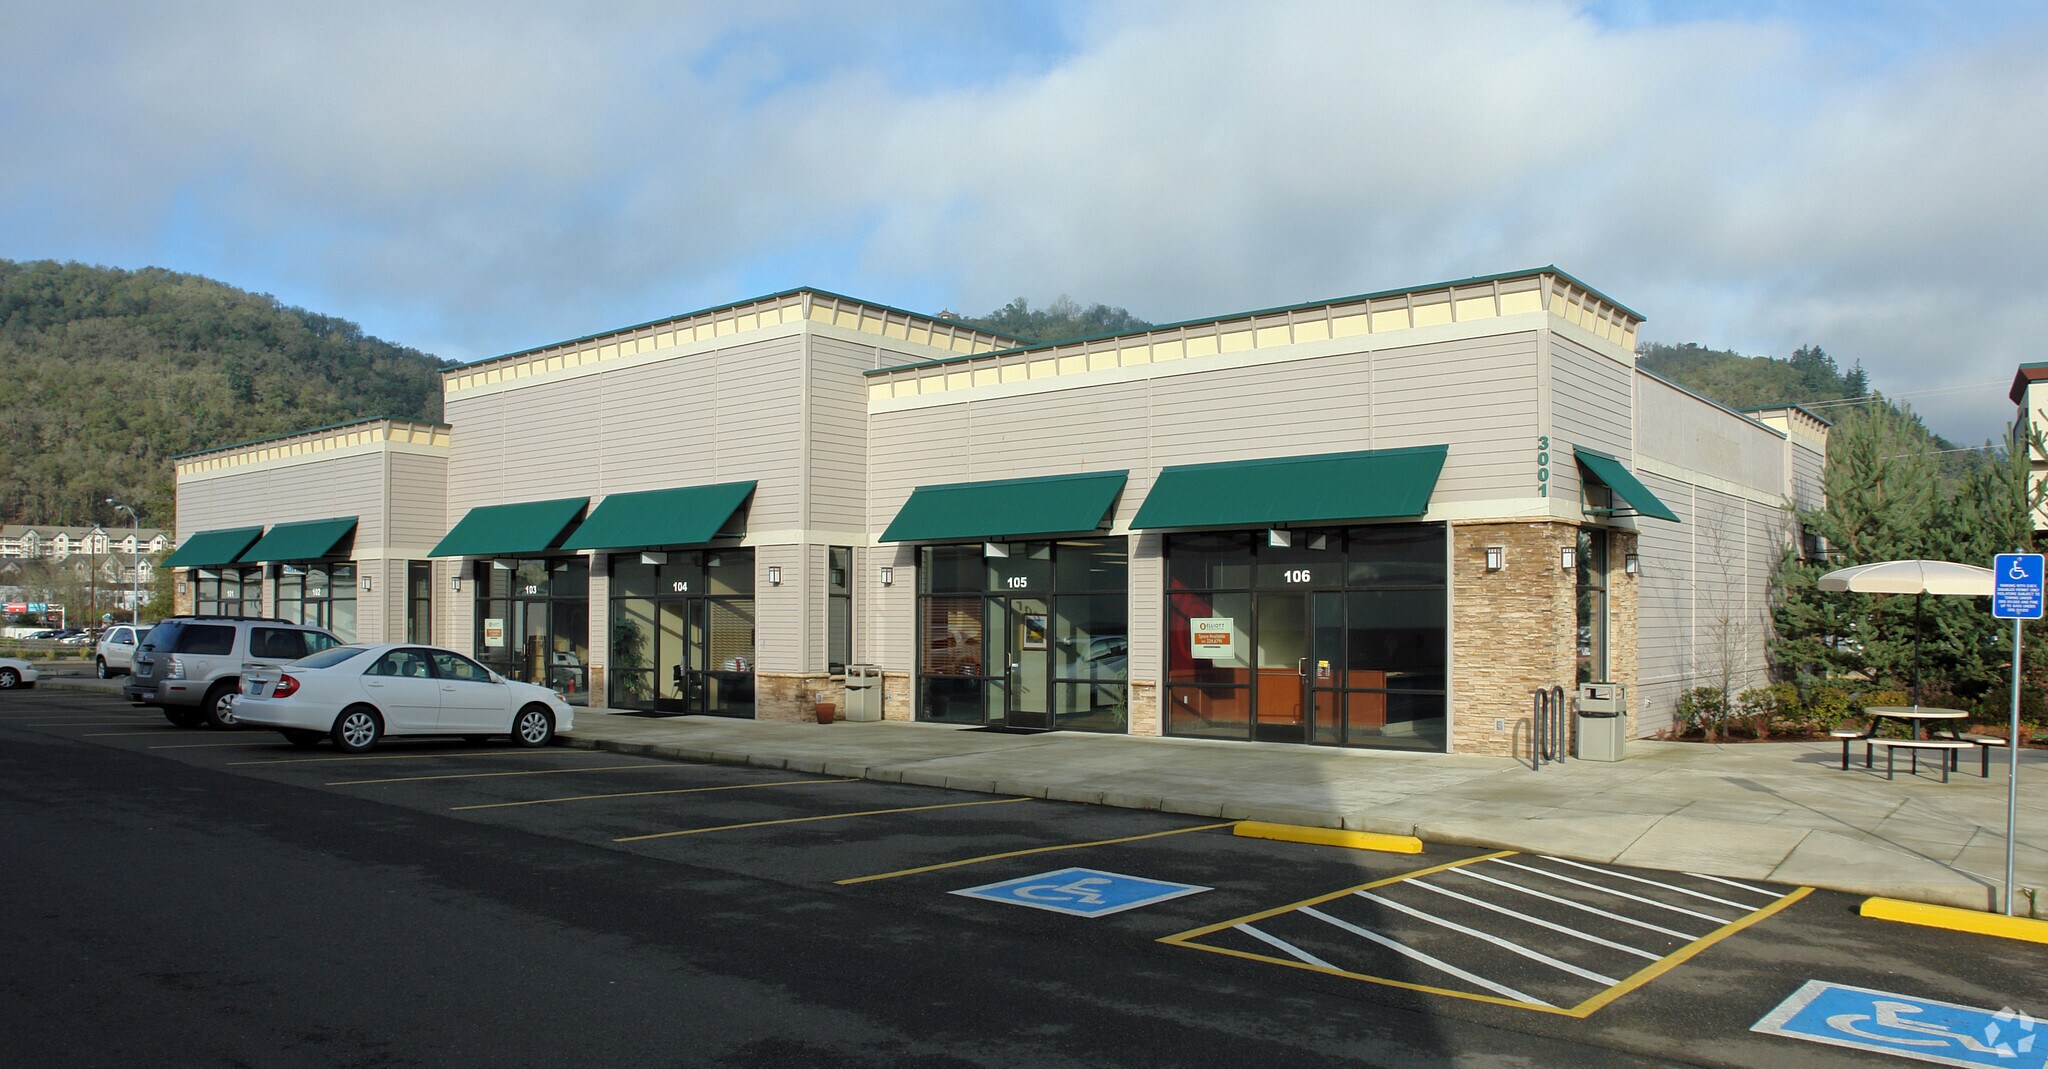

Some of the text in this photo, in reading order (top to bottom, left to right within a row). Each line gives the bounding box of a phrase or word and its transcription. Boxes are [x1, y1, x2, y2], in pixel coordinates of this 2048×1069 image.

[1538, 436, 1549, 497] 3001
[1007, 576, 1027, 588] 105
[1284, 570, 1311, 583] 106
[312, 588, 321, 596] 102
[525, 585, 537, 594] 103
[673, 582, 688, 592] 104
